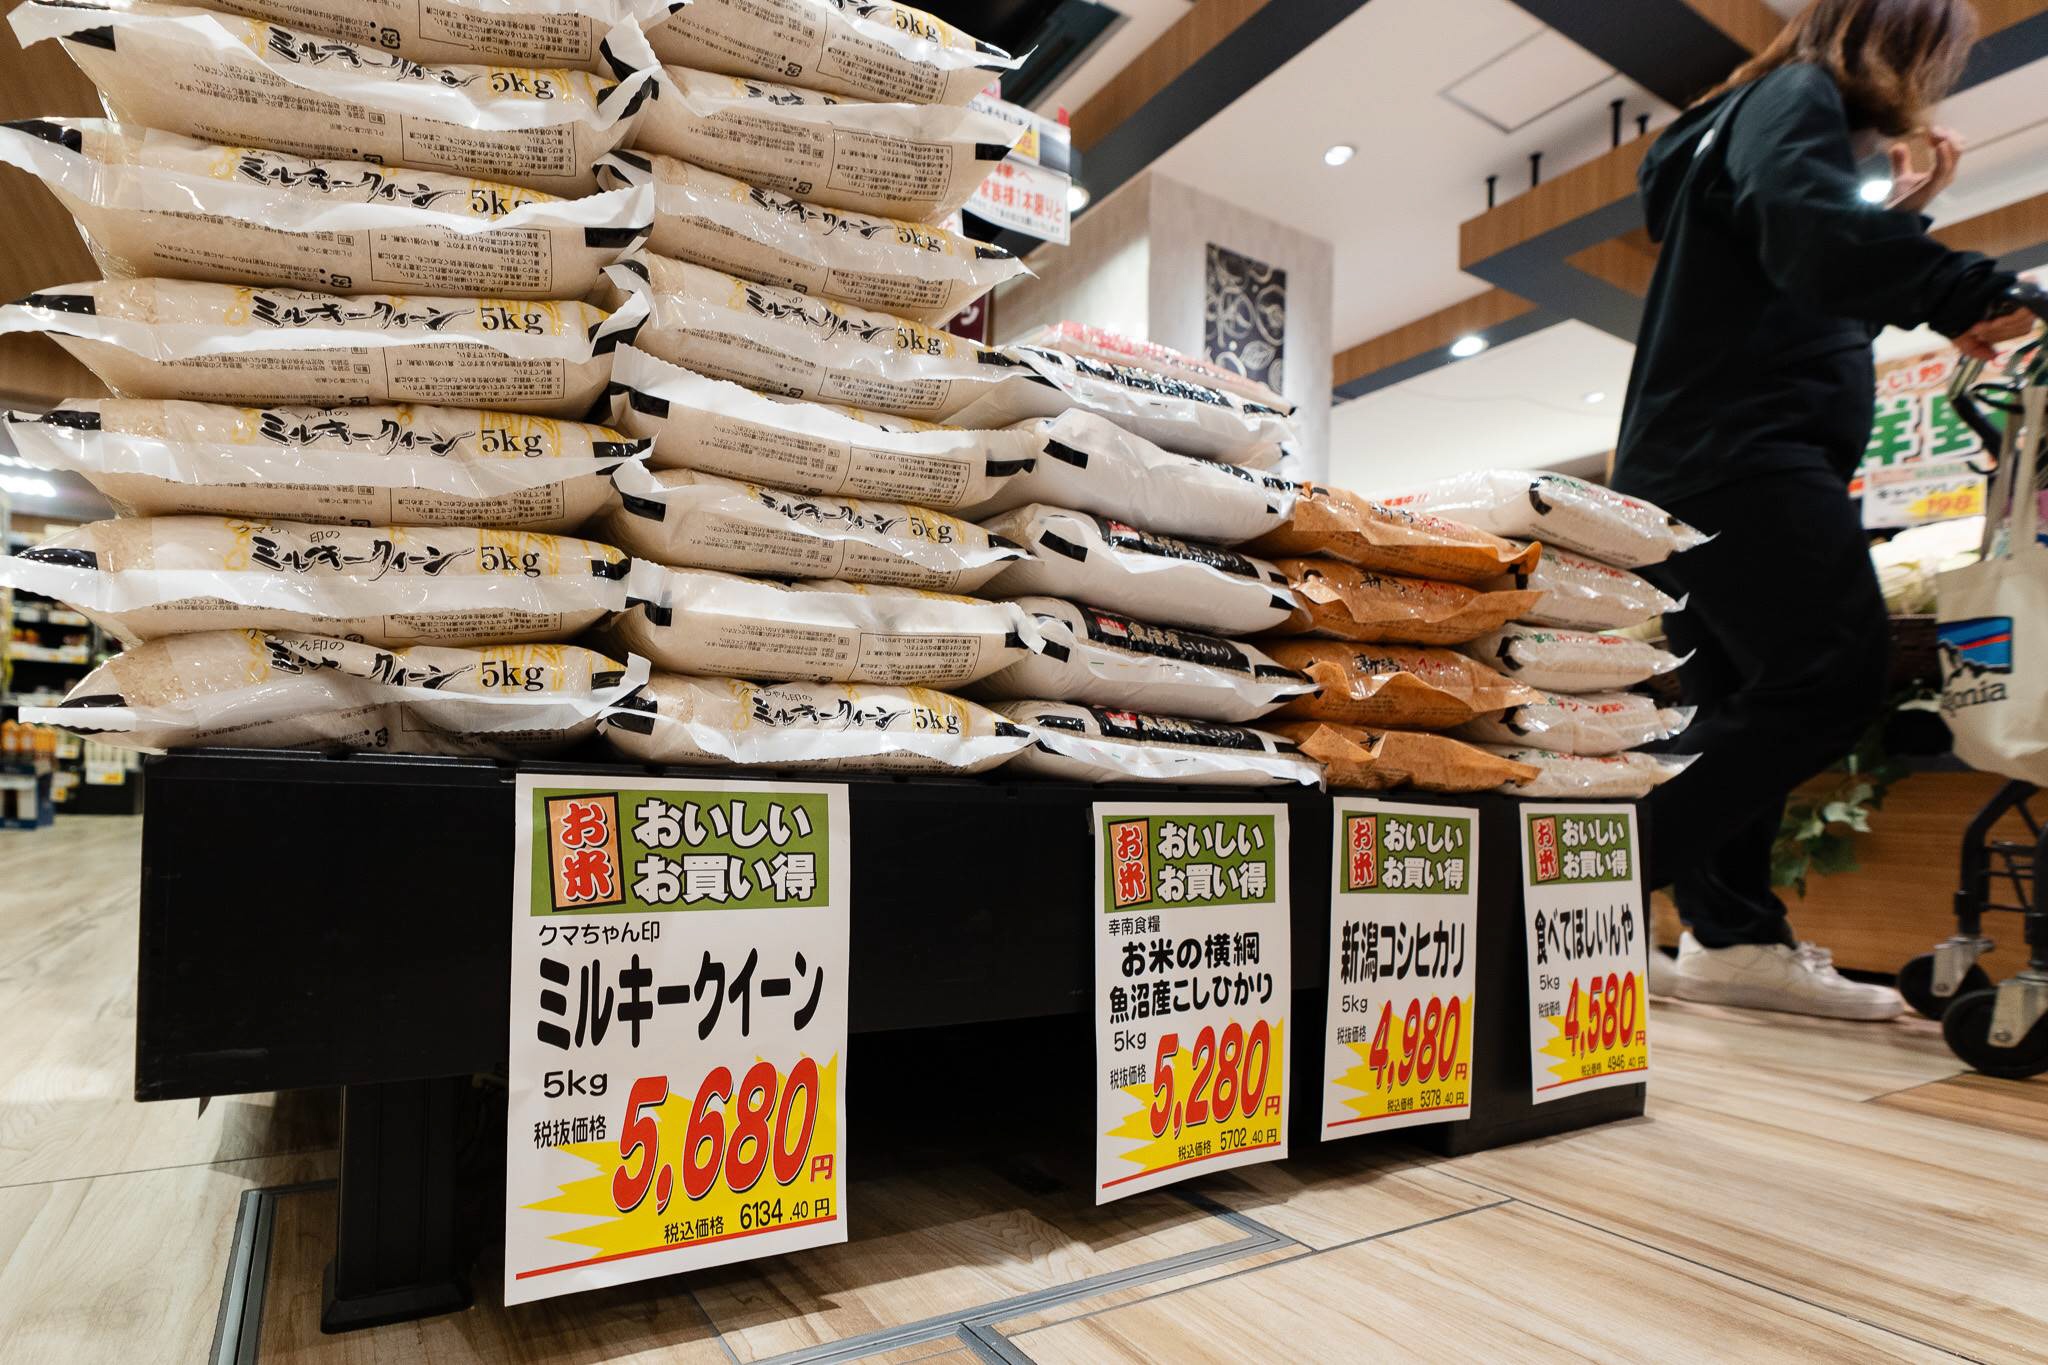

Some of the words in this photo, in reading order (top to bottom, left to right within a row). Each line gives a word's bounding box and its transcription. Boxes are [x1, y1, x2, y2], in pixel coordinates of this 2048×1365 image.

[896, 9, 938, 43] 5kg
[490, 72, 555, 100] 5kg
[480, 307, 543, 335] 5kg
[897, 328, 941, 356] 5kg
[481, 429, 543, 458] 5kg
[912, 517, 952, 543] 5kg
[481, 546, 541, 577] 5kg
[481, 661, 544, 690] 5kg
[914, 708, 960, 735] 5kg
[632, 797, 812, 848] おいしい
[1383, 818, 1464, 854] おいしい
[1562, 818, 1625, 847] おいしい
[561, 801, 613, 902] お米
[1156, 821, 1265, 860] おいしい
[1353, 820, 1374, 885] お米
[1537, 822, 1557, 878] お米
[631, 853, 816, 905] お買い得
[1118, 825, 1145, 900] お米
[1381, 855, 1464, 890] お買い得
[1562, 848, 1628, 879] お買い得
[1156, 861, 1267, 903] お買い得
[538, 921, 660, 946] クマちゃん印
[1108, 915, 1161, 936] 幸南食糧
[1535, 903, 1634, 965] 食べてほしいんや
[1121, 932, 1260, 977] お米の横綱
[1341, 920, 1465, 984] 新潟コシヒカリ
[537, 947, 824, 1051] ミルキークイーン
[1110, 972, 1273, 1024] 魚沼産こしひかり
[1539, 974, 1560, 991] 5kg
[1342, 995, 1368, 1013] 5kg
[1114, 1031, 1147, 1052] 5kg
[543, 1069, 608, 1099] 5kg
[1110, 1064, 1147, 1090] 税抜価格
[1420, 1089, 1442, 1109] 5378
[534, 1114, 607, 1149] 税抜価格
[1178, 1140, 1212, 1161] 税込価格
[1220, 1127, 1247, 1150] 5702
[664, 1216, 725, 1245] 税込価格
[740, 1198, 784, 1230] 6134
